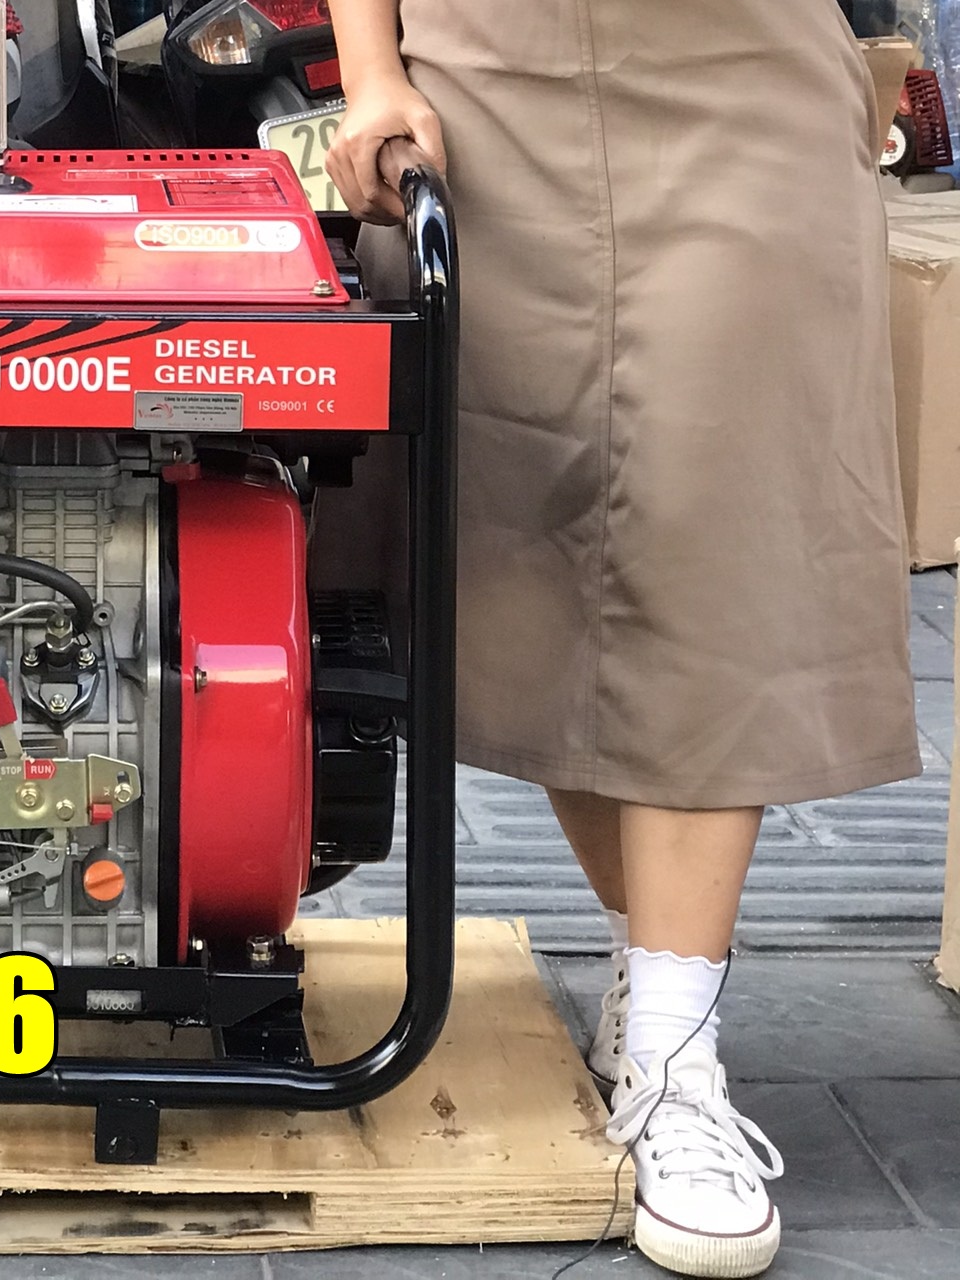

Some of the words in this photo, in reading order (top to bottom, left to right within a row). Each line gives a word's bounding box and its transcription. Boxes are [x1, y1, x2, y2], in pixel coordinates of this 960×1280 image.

[151, 224, 240, 245] ISO9001
[154, 338, 257, 360] DIESEL
[154, 365, 338, 387] GENERATOR
[258, 400, 308, 412] ISO9001
[0, 766, 22, 776] STOP
[30, 765, 52, 775] RUN
